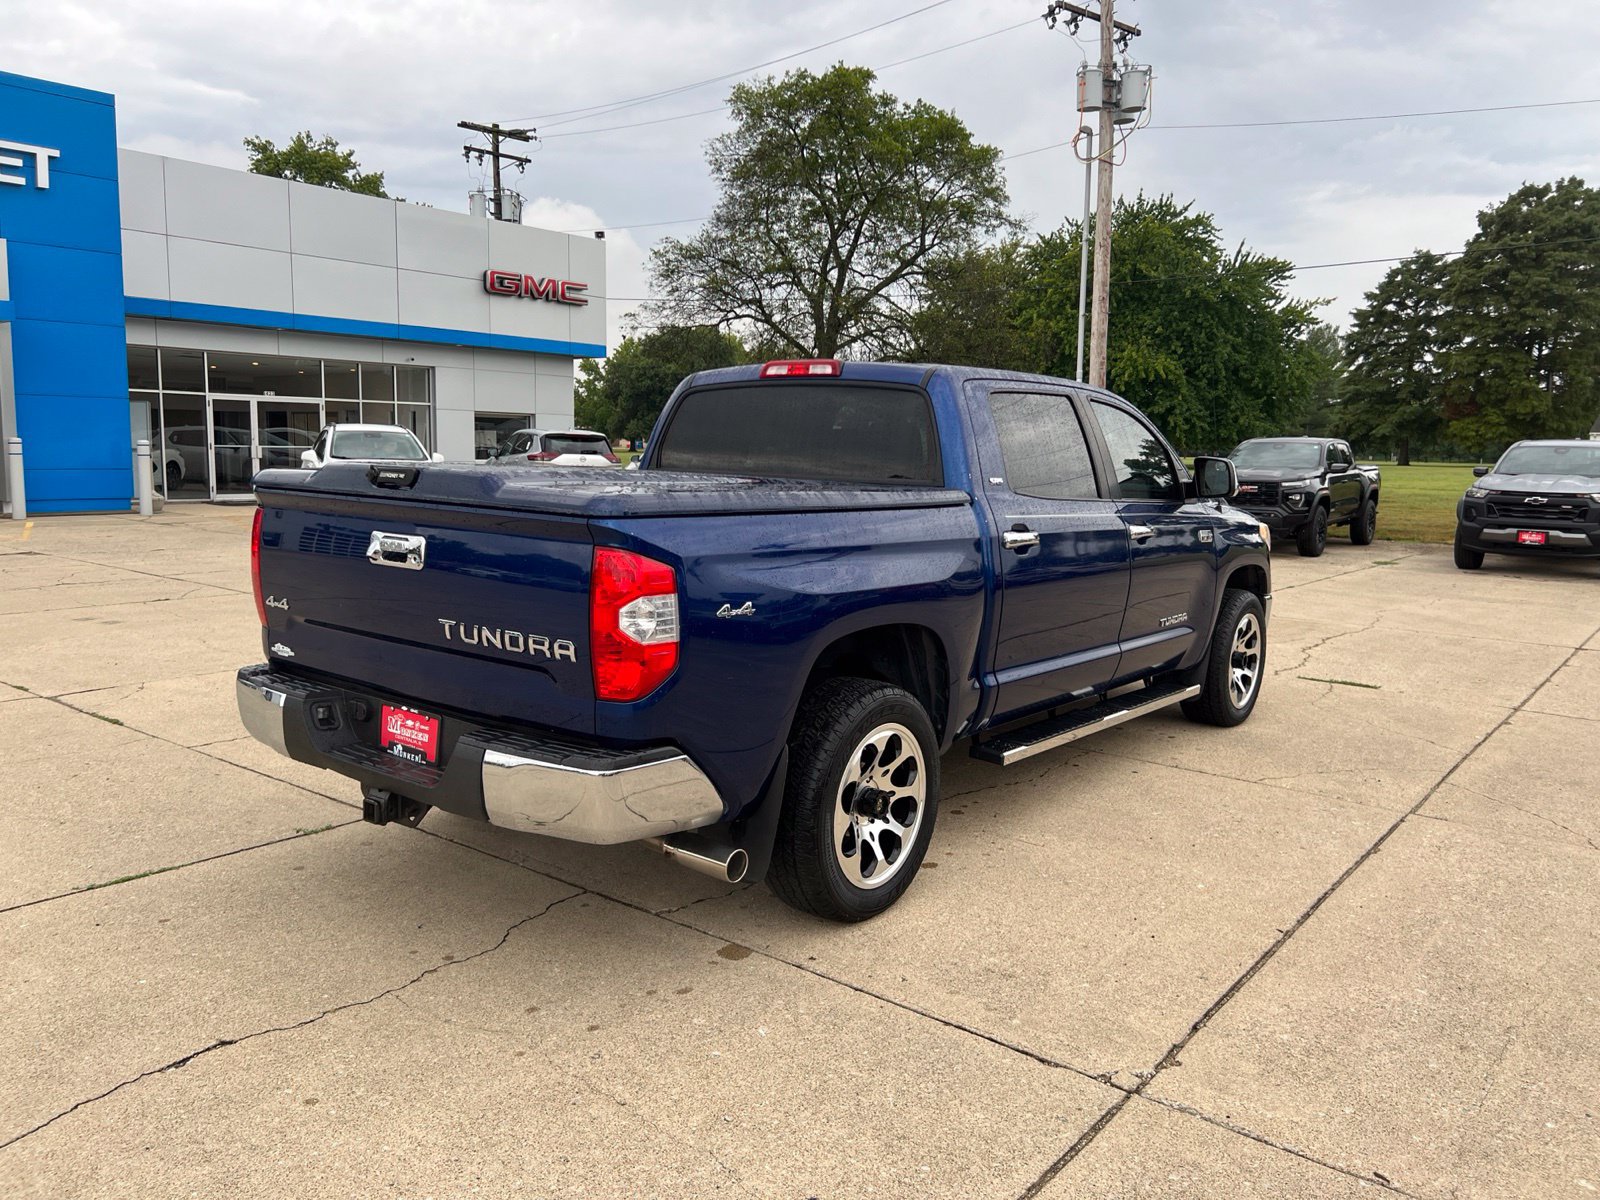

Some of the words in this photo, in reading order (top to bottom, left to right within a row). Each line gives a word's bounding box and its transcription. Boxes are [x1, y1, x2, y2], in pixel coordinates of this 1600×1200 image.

[484, 269, 588, 306] GMC
[265, 595, 289, 610] 4x4
[716, 601, 756, 619] 4x4
[1159, 612, 1188, 627] TUNDRA
[438, 618, 577, 663] TUNDRA
